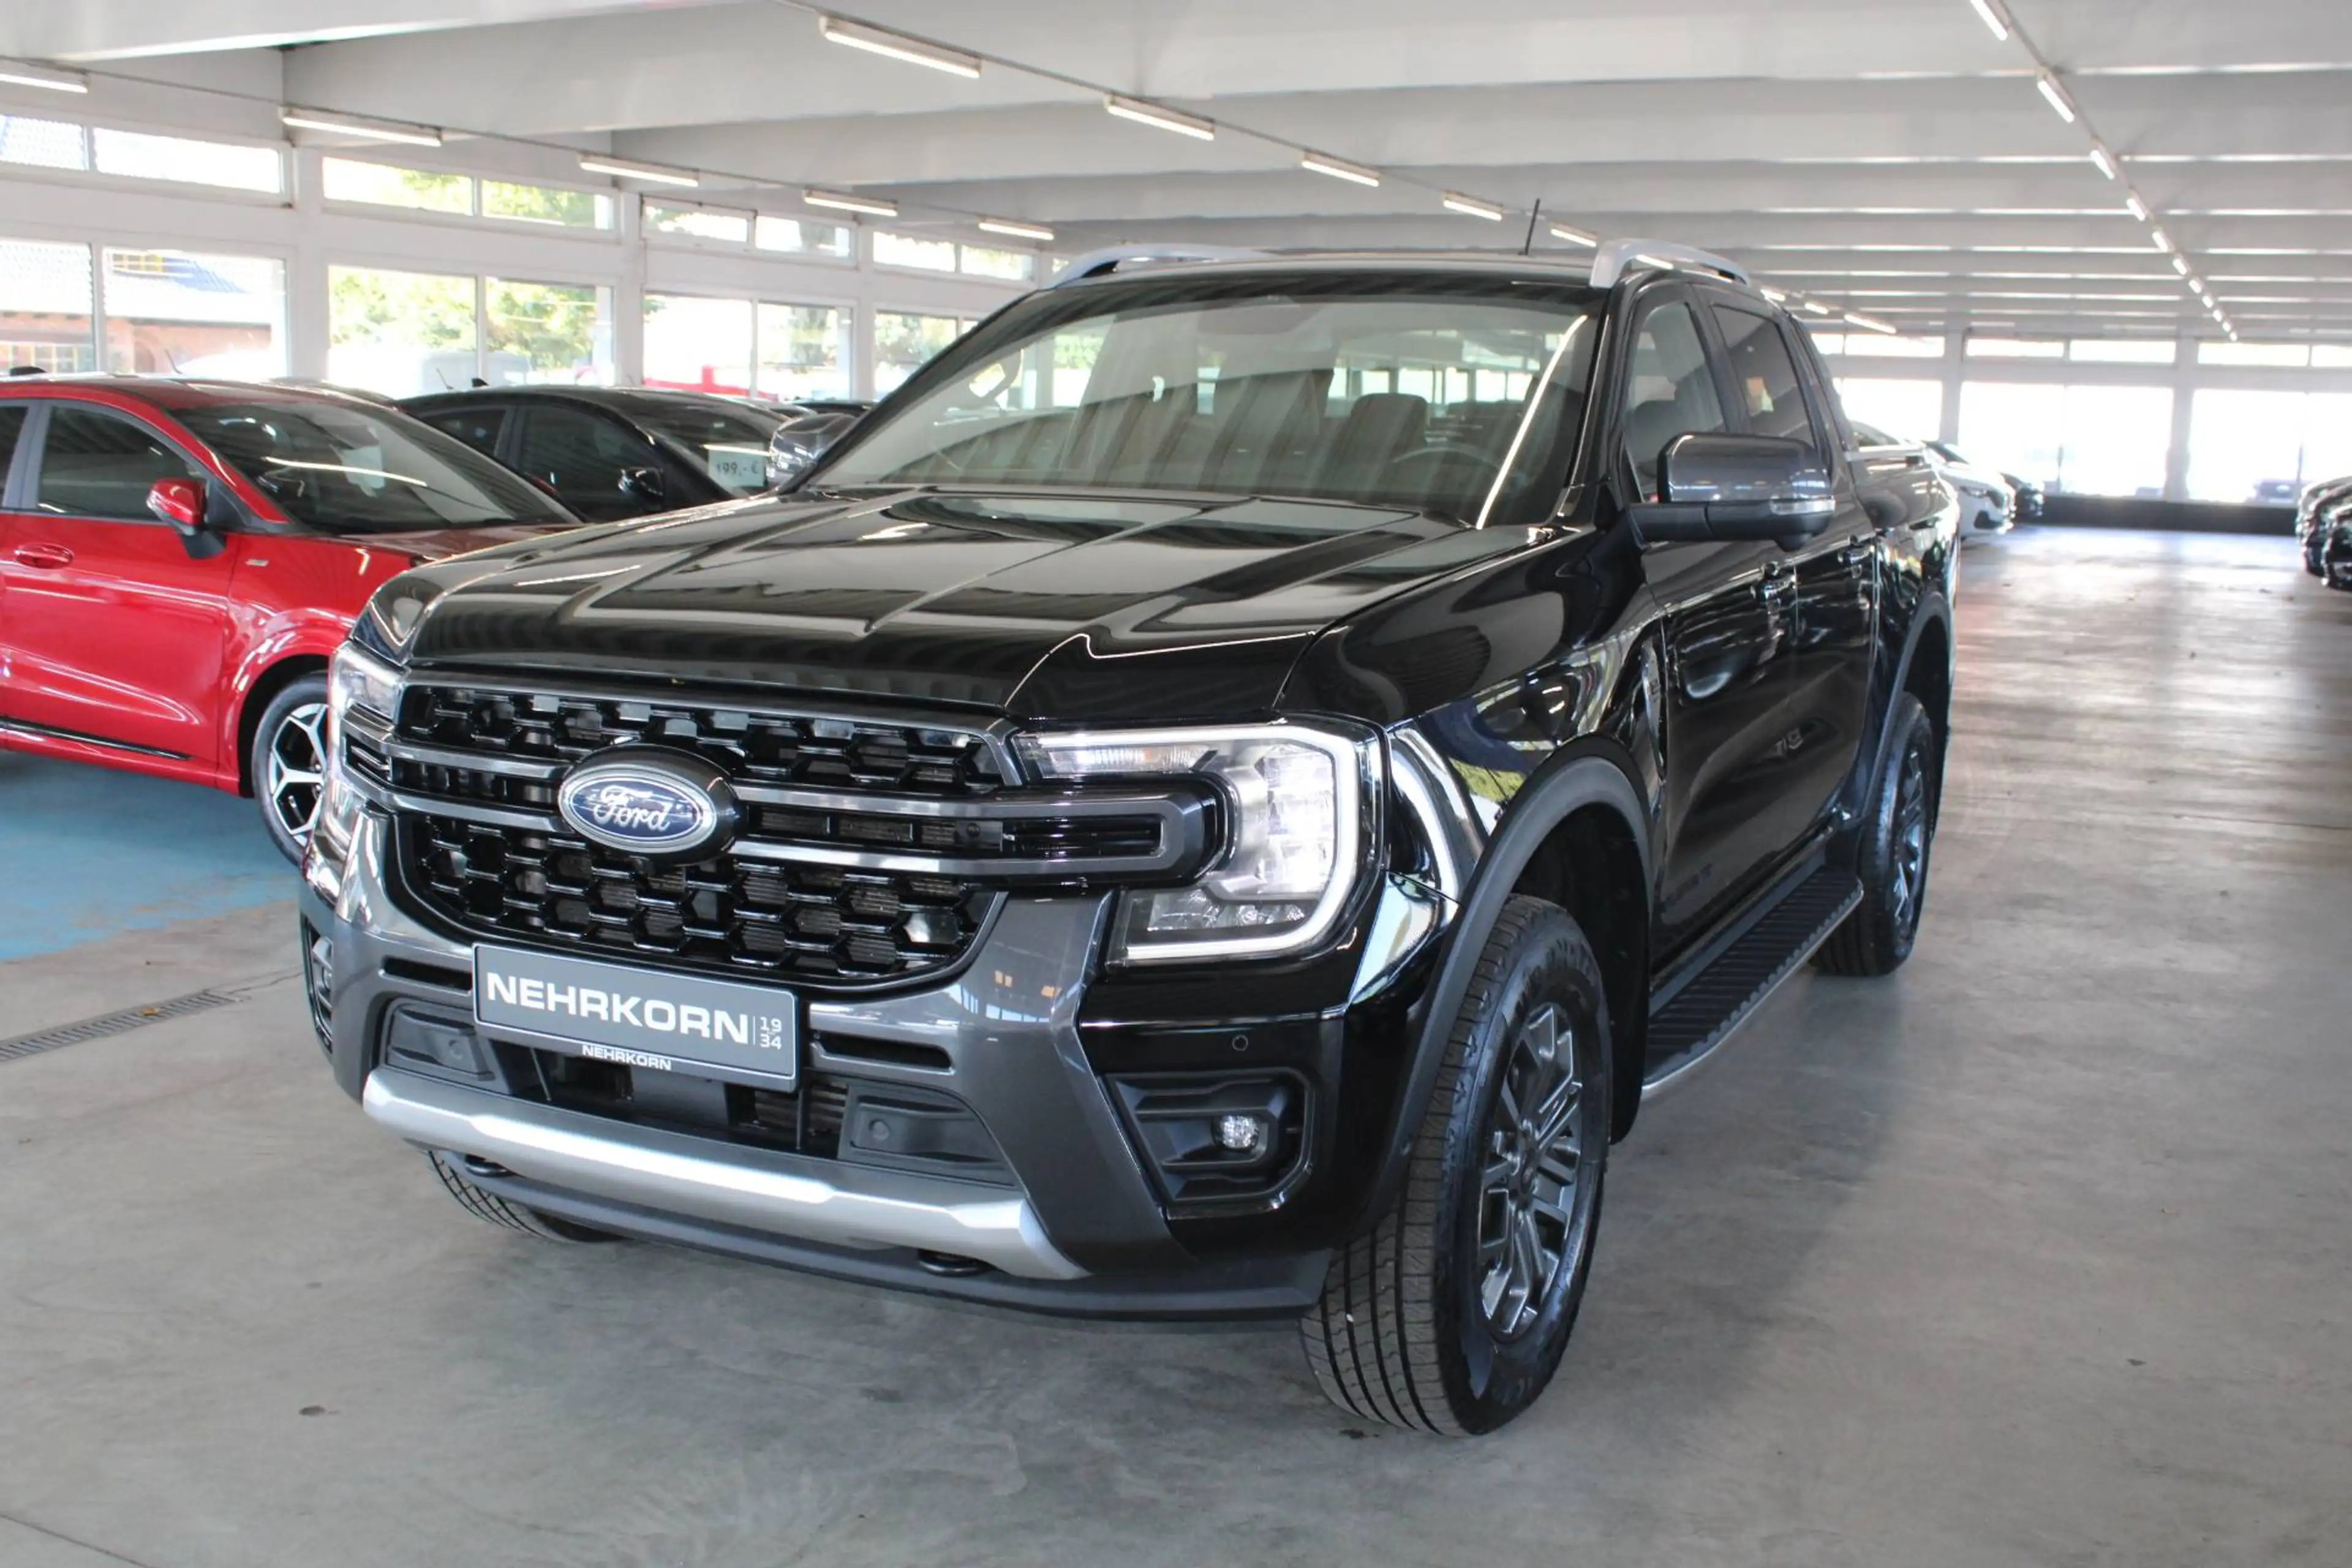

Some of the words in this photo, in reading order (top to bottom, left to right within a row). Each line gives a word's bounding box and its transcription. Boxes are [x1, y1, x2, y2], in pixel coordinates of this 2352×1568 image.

[593, 785, 673, 832] Ford
[487, 971, 748, 1044] NEHRKORN
[760, 1016, 782, 1033] 19
[760, 1033, 782, 1050] 34
[582, 1044, 672, 1071] NEHRKORN
